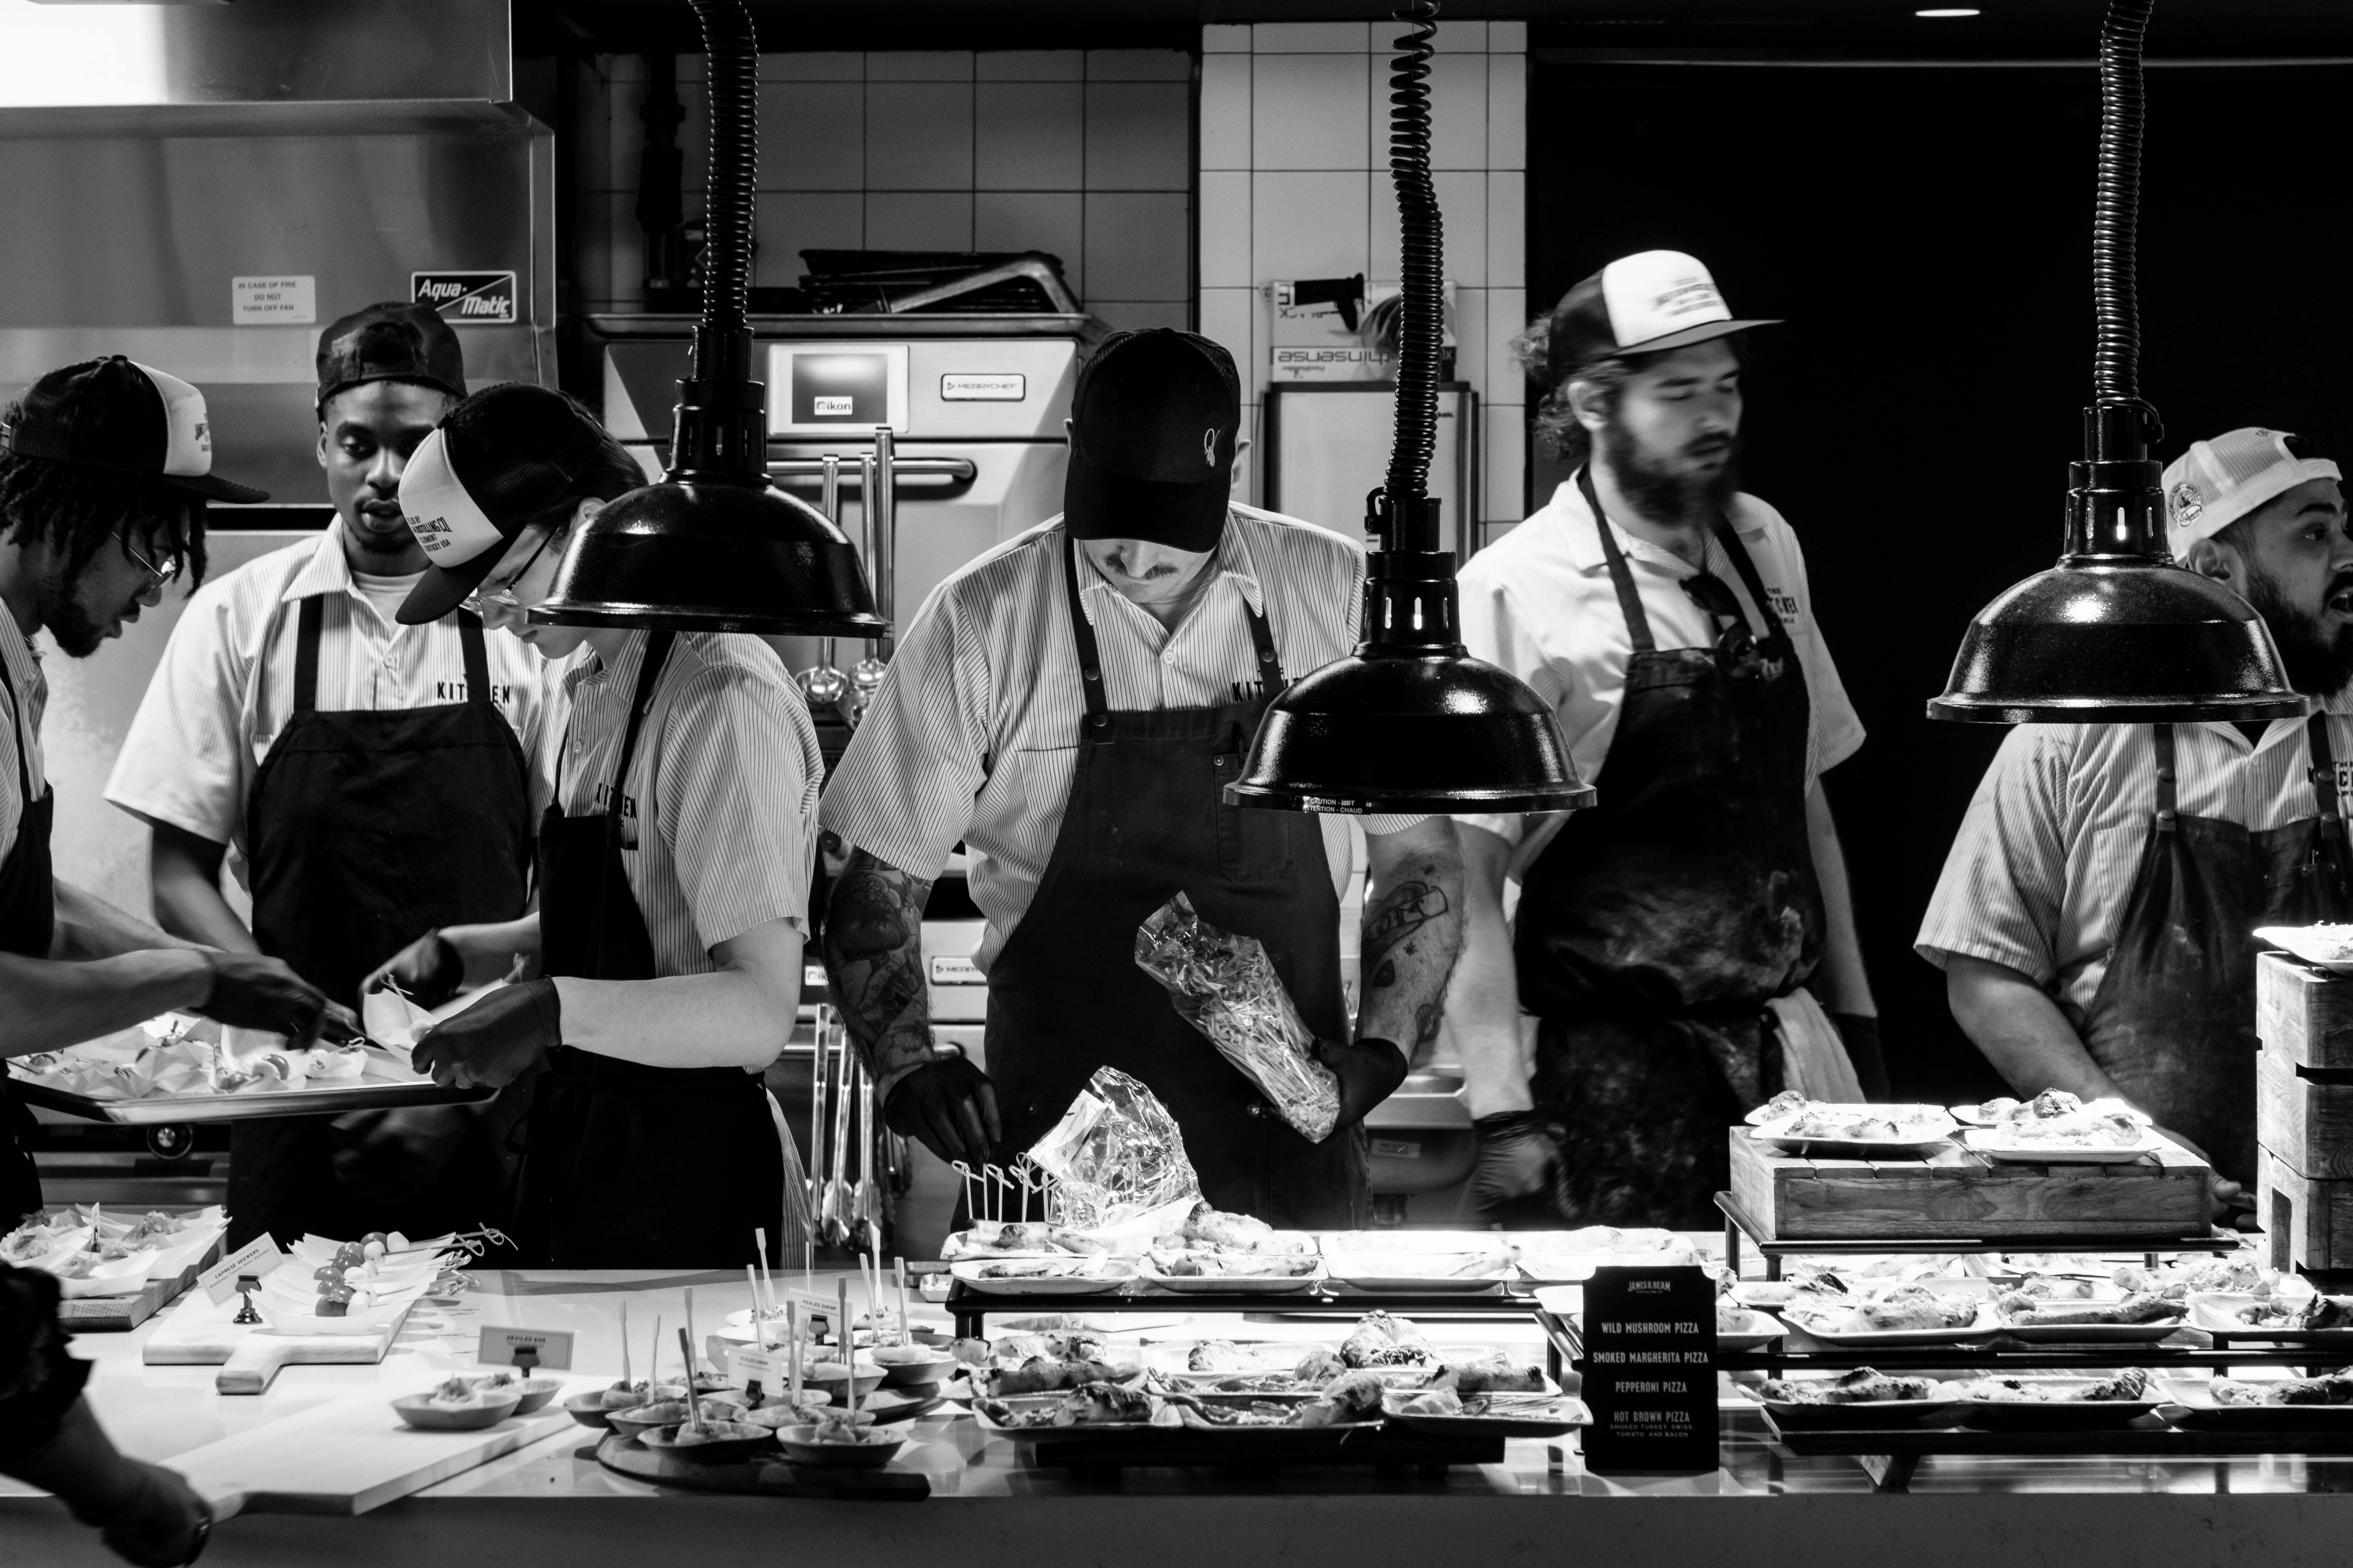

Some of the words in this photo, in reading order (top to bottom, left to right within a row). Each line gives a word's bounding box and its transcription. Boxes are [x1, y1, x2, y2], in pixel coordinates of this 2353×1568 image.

[418, 279, 467, 302] Aqua-
[461, 296, 511, 315] Matic
[1279, 351, 1390, 365] thinsense
[440, 539, 452, 547] USA
[437, 682, 510, 704] KITEN
[215, 1264, 236, 1279] CAPRESE
[237, 1249, 259, 1264] SKEWERS
[1627, 1281, 1647, 1292] JAMES
[1653, 1281, 1671, 1292] BEAM
[1601, 1322, 1622, 1334] WILD
[1625, 1322, 1671, 1334] MUSHROOM
[1675, 1322, 1699, 1334] PIZZA
[1593, 1351, 1626, 1364] SMOKED
[1629, 1351, 1681, 1364] MARGHERITA
[1684, 1351, 1709, 1364] PIZZA
[1615, 1381, 1659, 1393] PEPPERONI
[1663, 1381, 1688, 1393] PIZZA
[1614, 1411, 1629, 1422] HOT
[1633, 1411, 1662, 1422] BROWN
[1665, 1411, 1691, 1422] PIZZA
